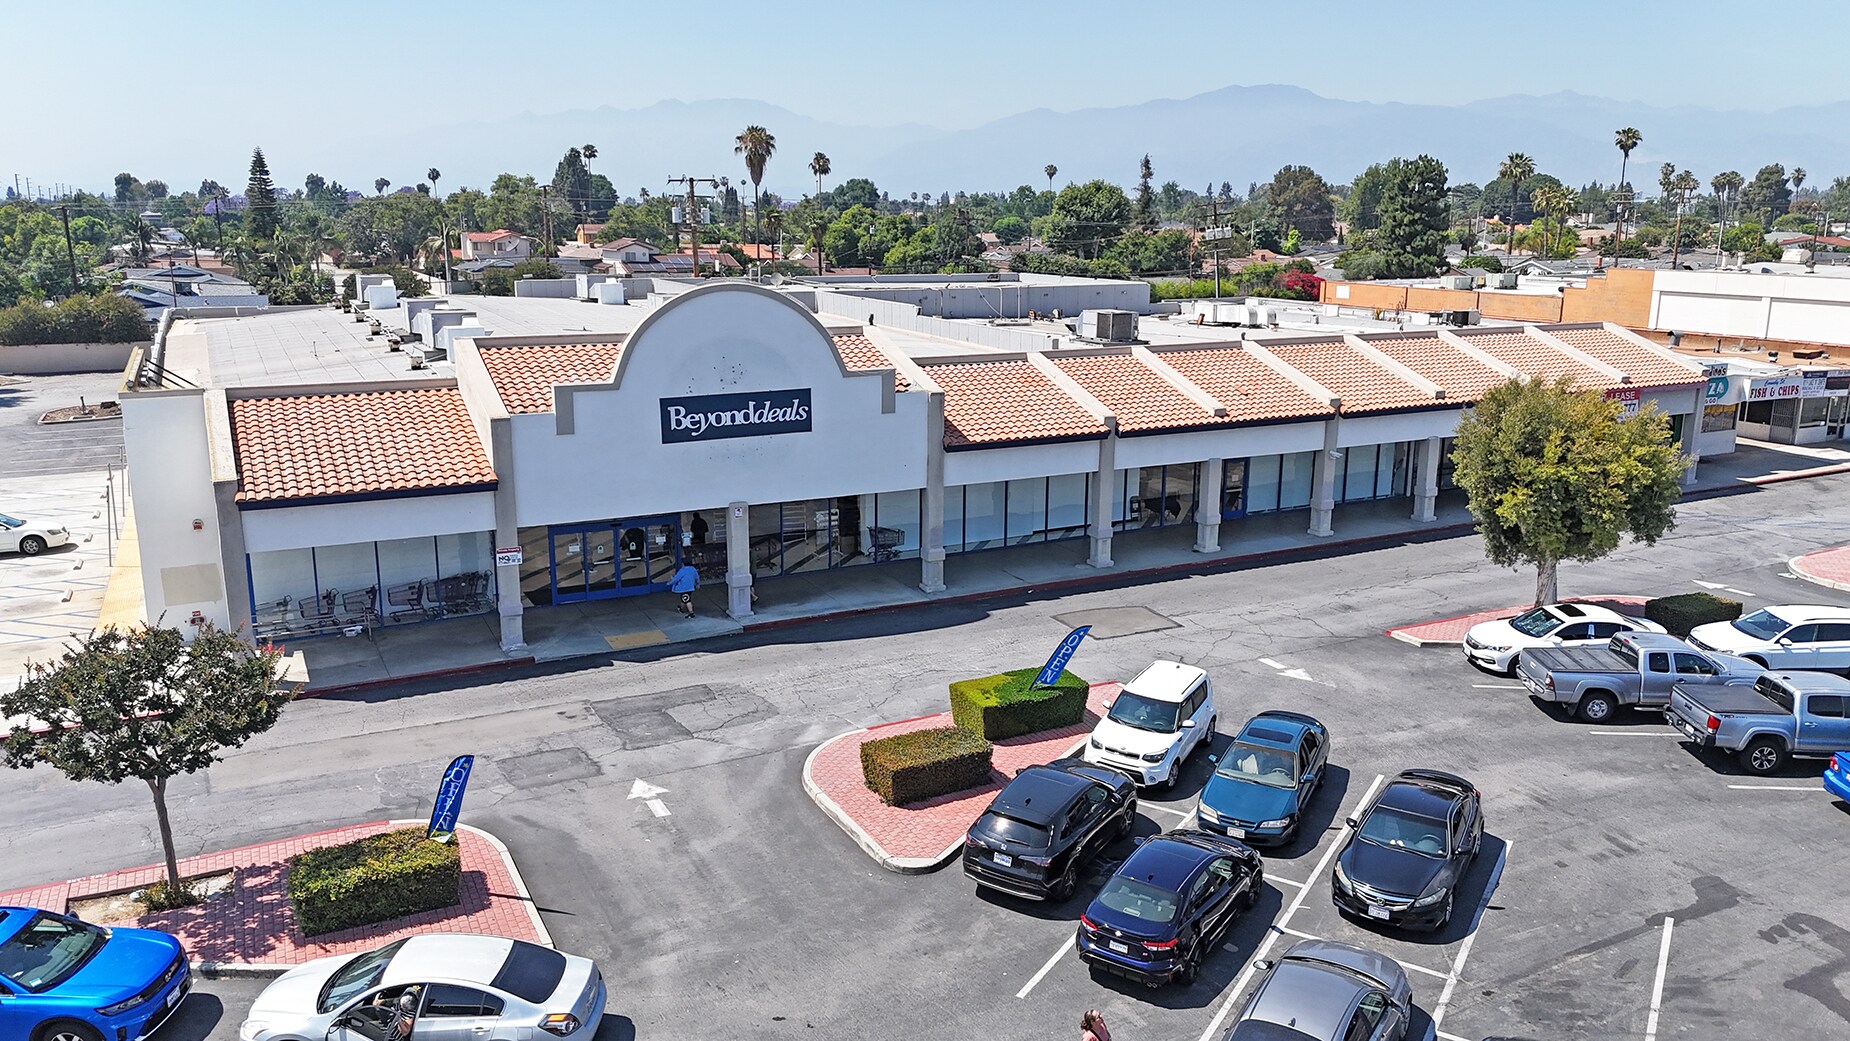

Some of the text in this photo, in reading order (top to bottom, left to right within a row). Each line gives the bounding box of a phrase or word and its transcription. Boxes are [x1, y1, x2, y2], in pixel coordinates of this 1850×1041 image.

[1750, 387, 1768, 399] FISH
[1770, 387, 1775, 397] &
[1778, 385, 1800, 397] CHIPS
[667, 398, 809, 436] Beyonddeals
[1041, 634, 1079, 683] OPEN
